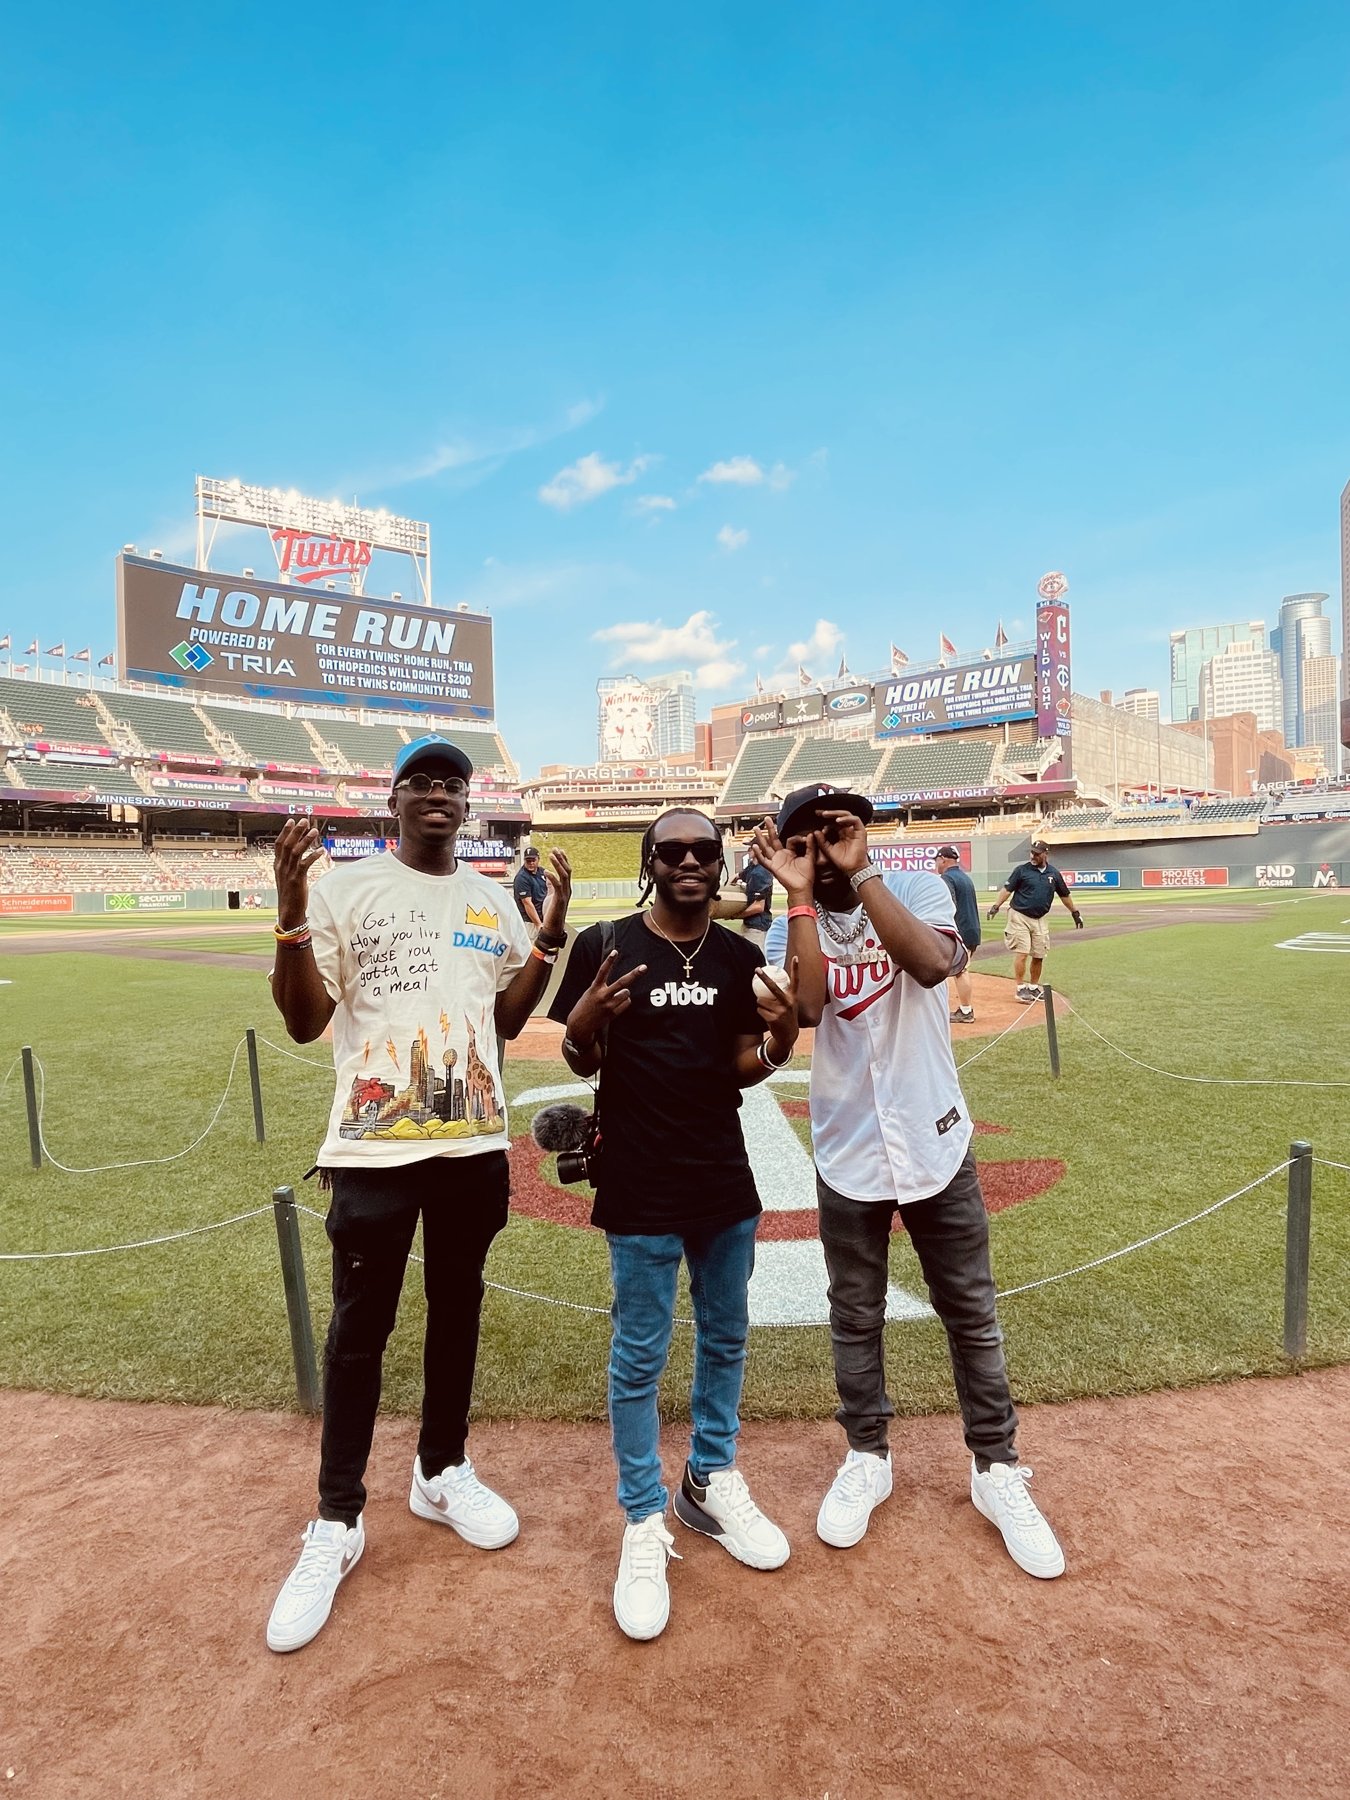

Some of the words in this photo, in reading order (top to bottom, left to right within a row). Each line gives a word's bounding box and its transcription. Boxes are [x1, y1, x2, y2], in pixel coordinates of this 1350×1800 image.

[271, 529, 372, 572] Twins
[175, 582, 342, 639] HOME
[351, 609, 456, 655] RUN
[189, 626, 255, 649] POWERED
[257, 635, 275, 651] BY
[1040, 632, 1051, 665] WILD
[219, 651, 297, 677] TRIA
[315, 643, 336, 656] FOR
[337, 645, 368, 660] EVERY
[369, 650, 403, 664] TWINS'
[404, 655, 430, 668] HOME
[431, 658, 452, 671] RUN,
[453, 660, 474, 673] TRIA
[318, 658, 387, 676] ORTHOPEDICS
[388, 666, 411, 679] WILL
[412, 669, 447, 684] DONATE
[447, 673, 472, 686] $200
[321, 672, 335, 685] TO
[336, 674, 356, 687] THE
[357, 676, 389, 690] TWINS
[389, 680, 445, 697] COMMUNITY
[445, 686, 472, 699] FUND.
[884, 673, 958, 706] HOME
[962, 663, 1022, 693] RUN
[1042, 669, 1051, 710] NIGHT
[605, 693, 626, 706] Win!
[627, 693, 658, 704] Twins!
[837, 697, 860, 709] Ford
[889, 702, 918, 714] POWERED
[918, 701, 927, 710] BY
[754, 709, 777, 724] pepsi
[903, 710, 936, 724] TRIA
[566, 767, 632, 779] TARGET
[649, 766, 698, 778] FIELD
[173, 780, 213, 790] Treasure
[214, 781, 241, 792] Island
[275, 787, 298, 796] Home
[315, 788, 333, 798] Deck
[95, 795, 166, 806] MINNESOTA
[167, 798, 196, 807] WILD
[198, 800, 231, 809] NIGHT
[866, 792, 921, 803] INNESOTA
[921, 790, 951, 800] WILD
[953, 788, 989, 797] NIGHT
[1261, 815, 1287, 823] Corona
[1292, 813, 1319, 821] Corona
[334, 839, 375, 848] UPCOMING
[456, 840, 473, 848] METS
[483, 840, 504, 848] TWINS
[330, 847, 352, 857] HOME
[353, 847, 380, 856] GAMES
[454, 847, 494, 857] EPTEMBER
[494, 847, 512, 857] 8-10
[1074, 871, 1108, 883] bank
[1161, 869, 1205, 878] PROJECT
[1161, 877, 1206, 886] SUCCESS
[1, 897, 67, 907] Schneiderman's
[138, 894, 182, 903] securian
[362, 911, 397, 931] Get
[409, 910, 428, 923] It
[350, 933, 381, 952] How
[390, 931, 413, 947] you
[360, 964, 400, 988] gotta
[409, 958, 439, 975] eat
[372, 986, 382, 997] a
[390, 976, 429, 994] meal
